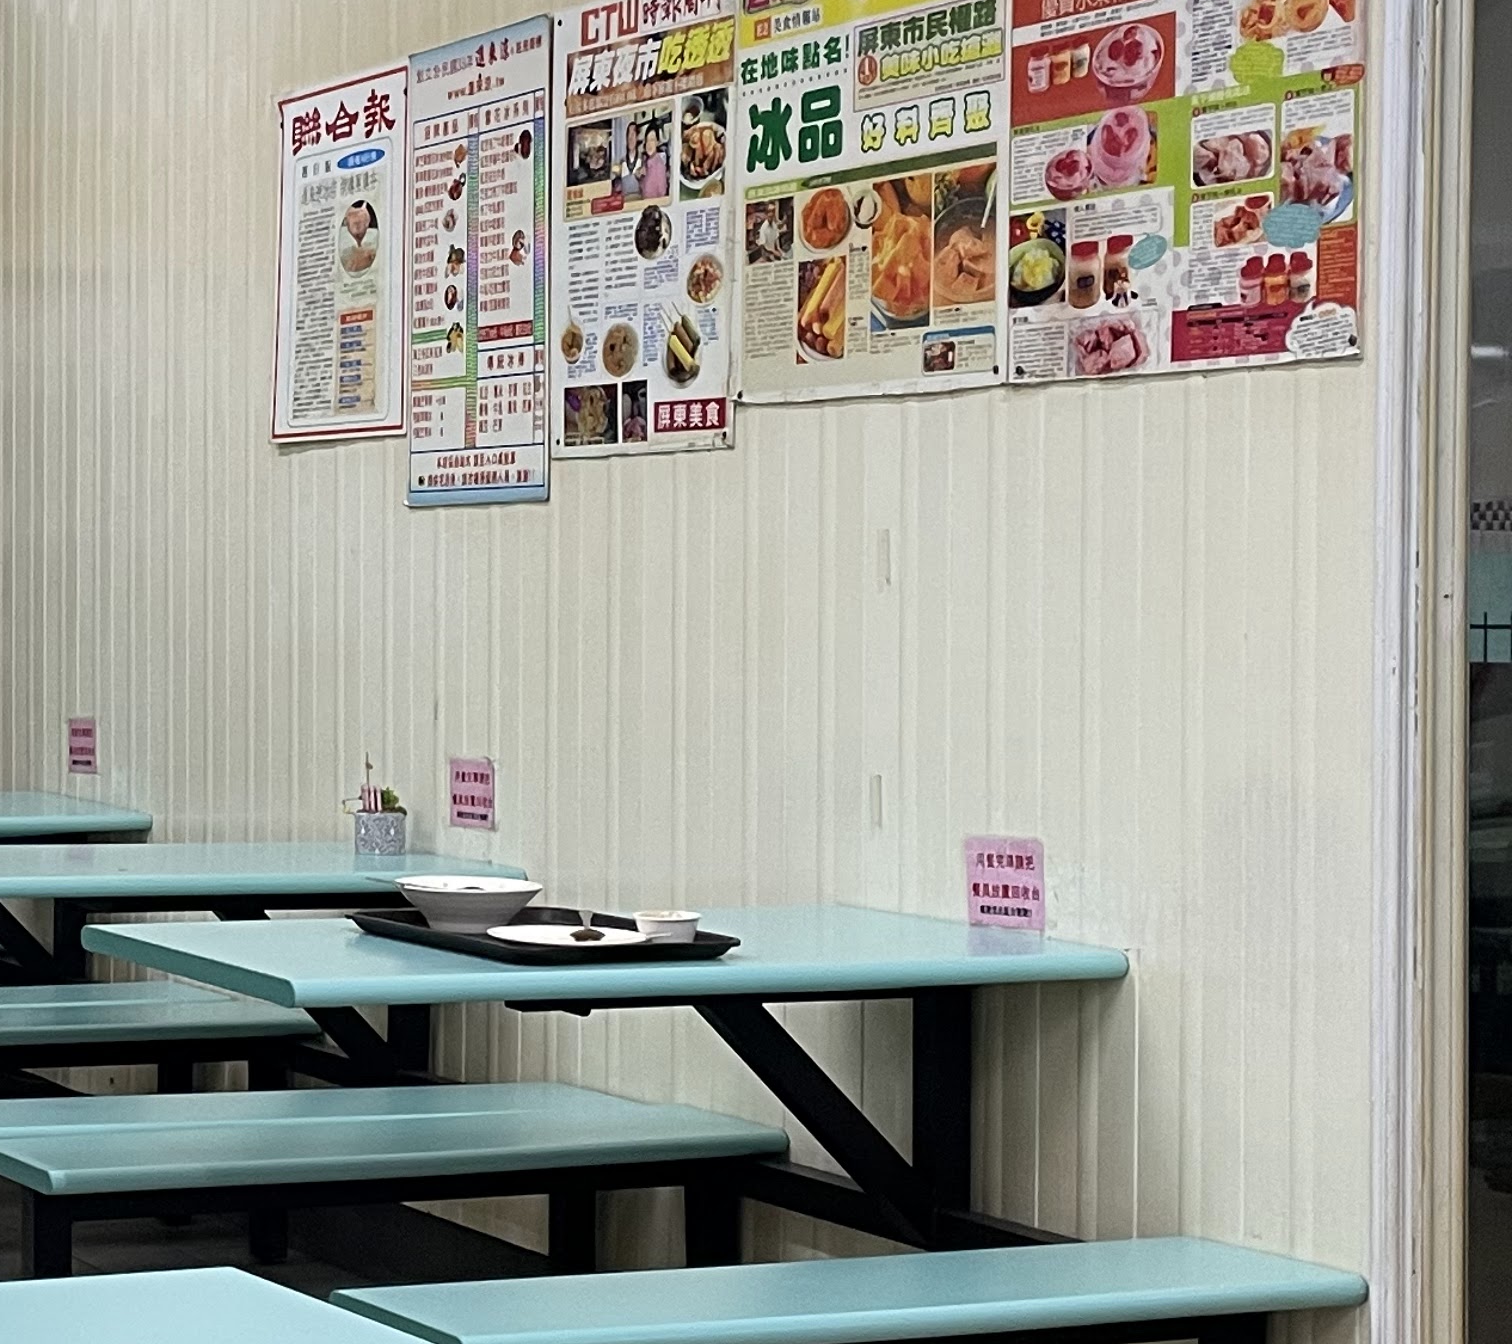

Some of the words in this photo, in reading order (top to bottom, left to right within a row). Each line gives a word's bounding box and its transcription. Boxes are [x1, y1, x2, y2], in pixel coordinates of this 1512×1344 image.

[292, 88, 396, 156] 聯合報
[746, 85, 843, 173] 冰品
[657, 400, 721, 429] 屏東美食
